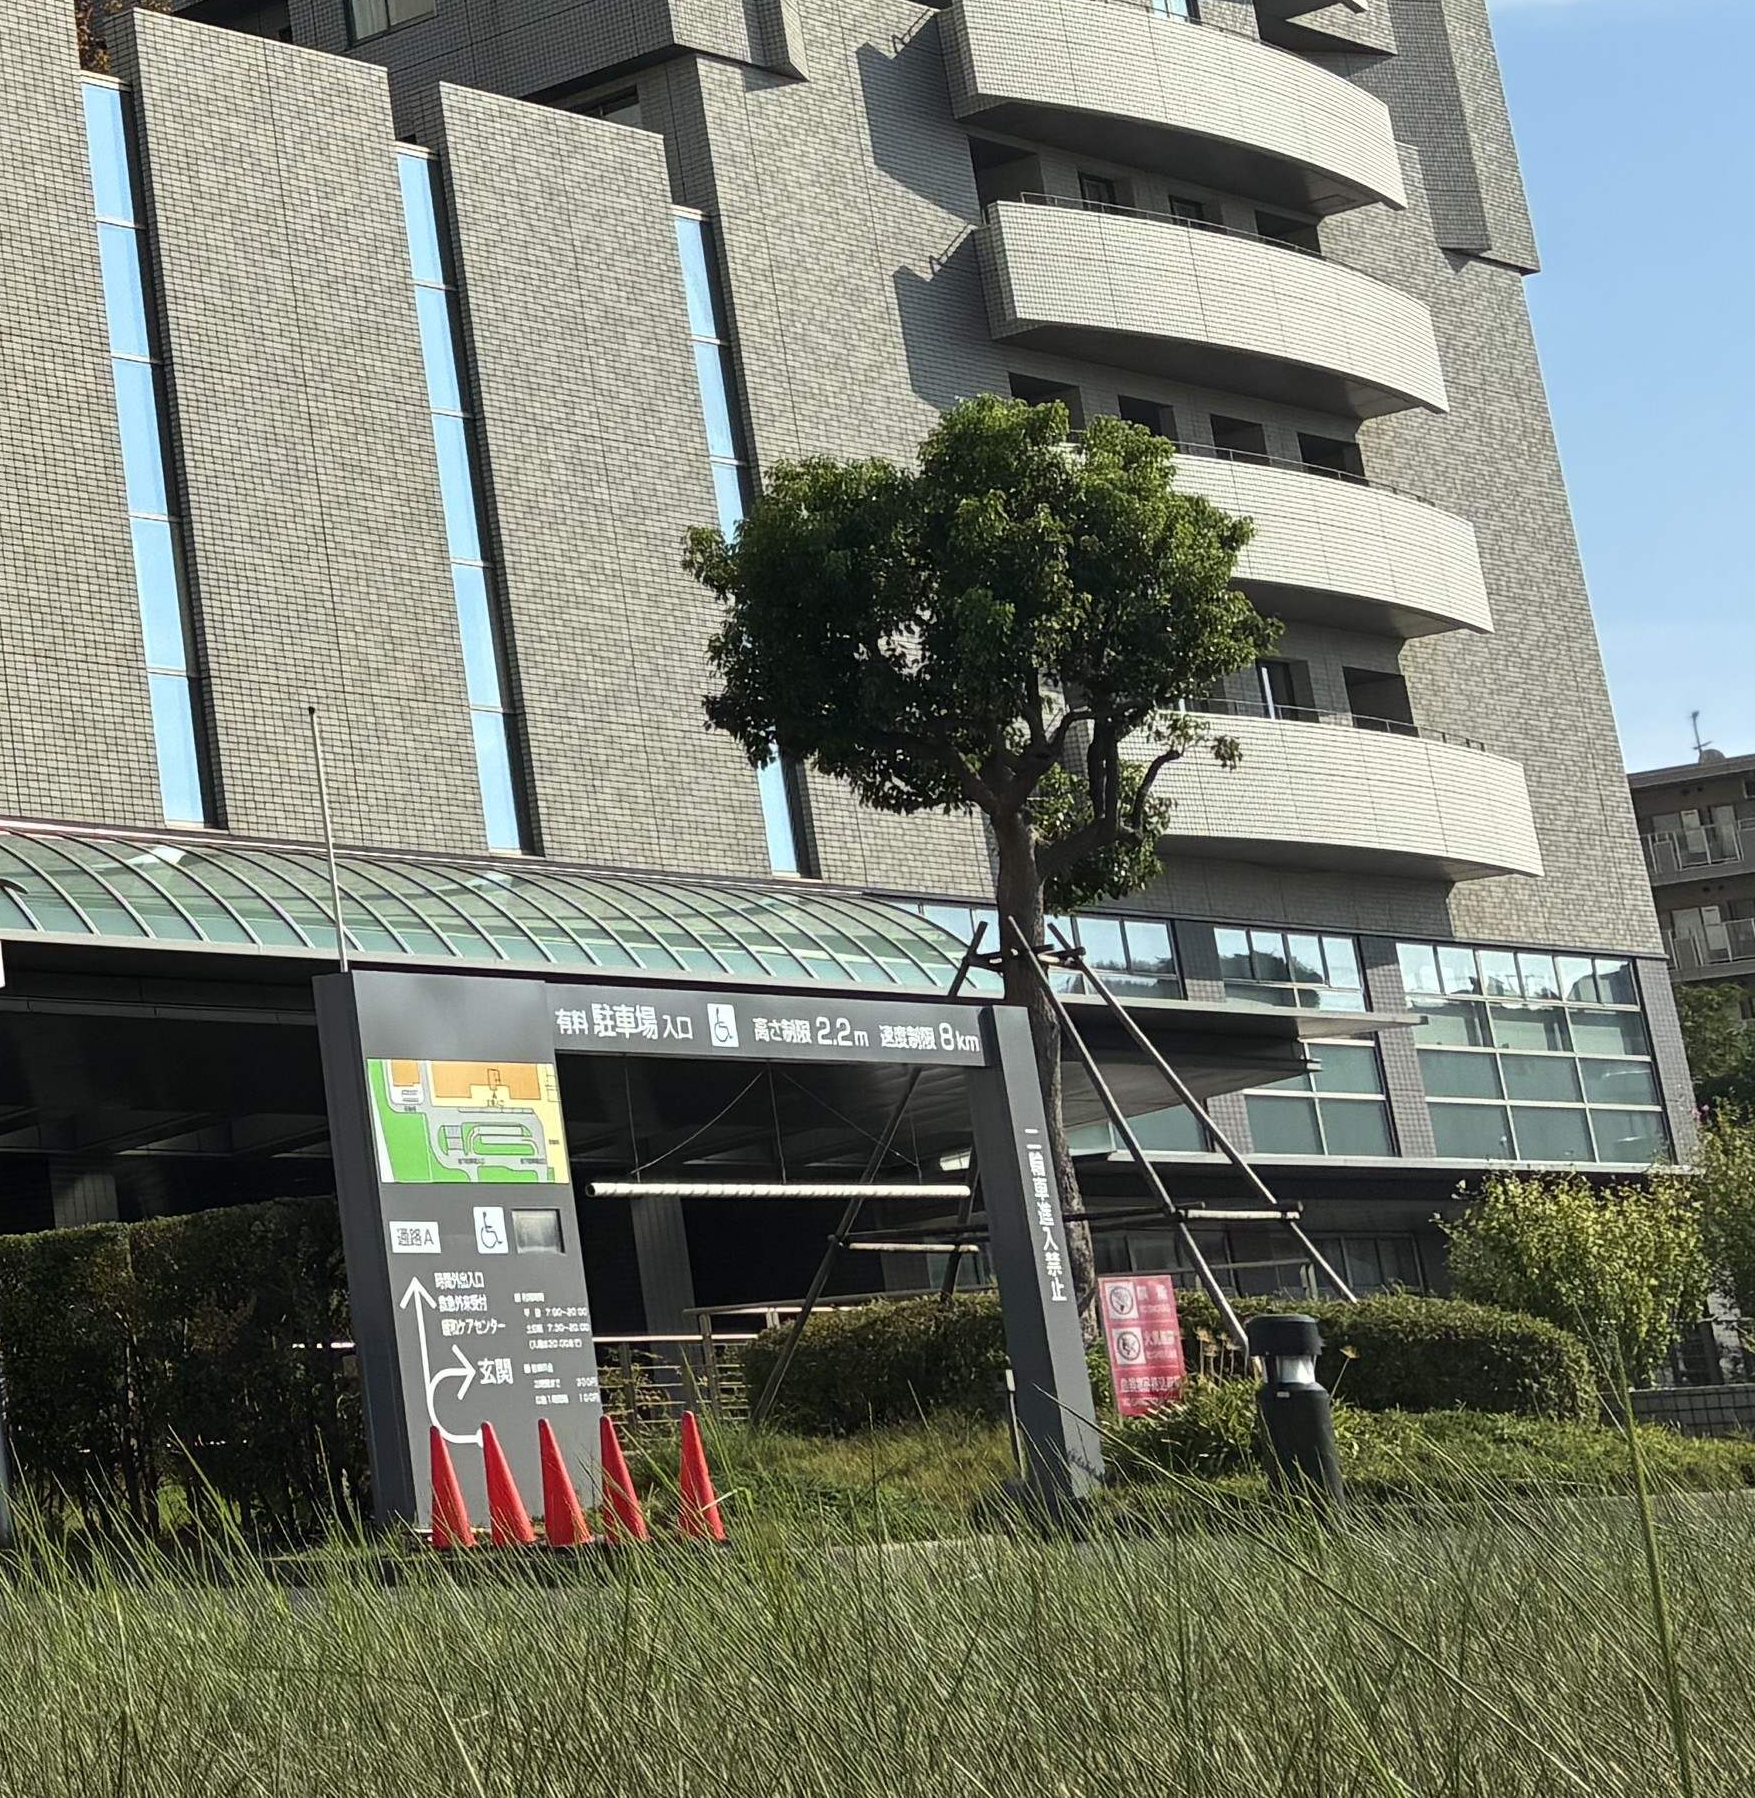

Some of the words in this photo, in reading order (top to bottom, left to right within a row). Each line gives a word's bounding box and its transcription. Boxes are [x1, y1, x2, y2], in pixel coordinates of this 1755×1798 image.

[752, 1017, 811, 1044] 高さ制限
[815, 1016, 869, 1047] 2.2m
[878, 1025, 937, 1051] 速度制限
[1024, 1128, 1067, 1301] 二輪車進入禁止
[477, 1358, 514, 1384] 玄関
